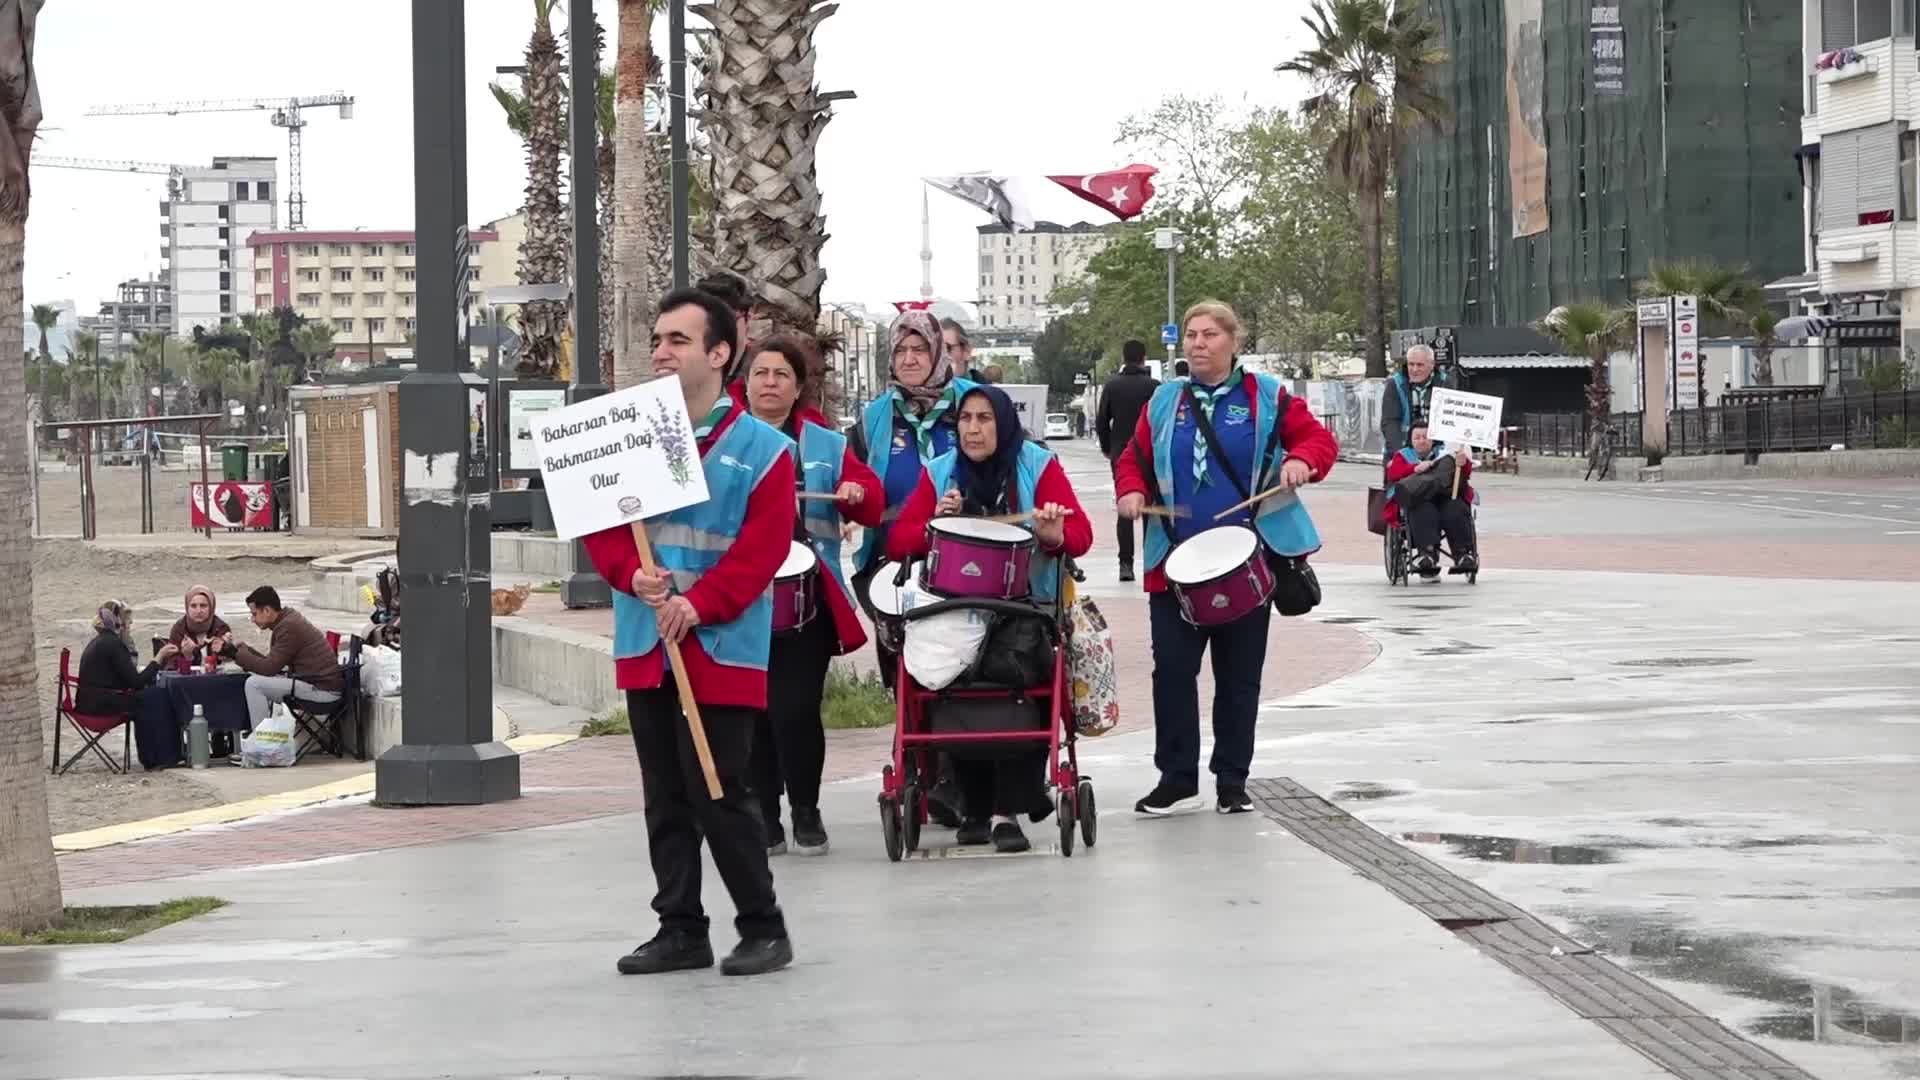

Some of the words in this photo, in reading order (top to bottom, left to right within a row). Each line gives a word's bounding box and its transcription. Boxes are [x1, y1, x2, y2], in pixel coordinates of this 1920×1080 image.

[541, 415, 607, 443] Bakarsan
[544, 441, 622, 473] Bakmazsan
[590, 472, 620, 490] Olur
